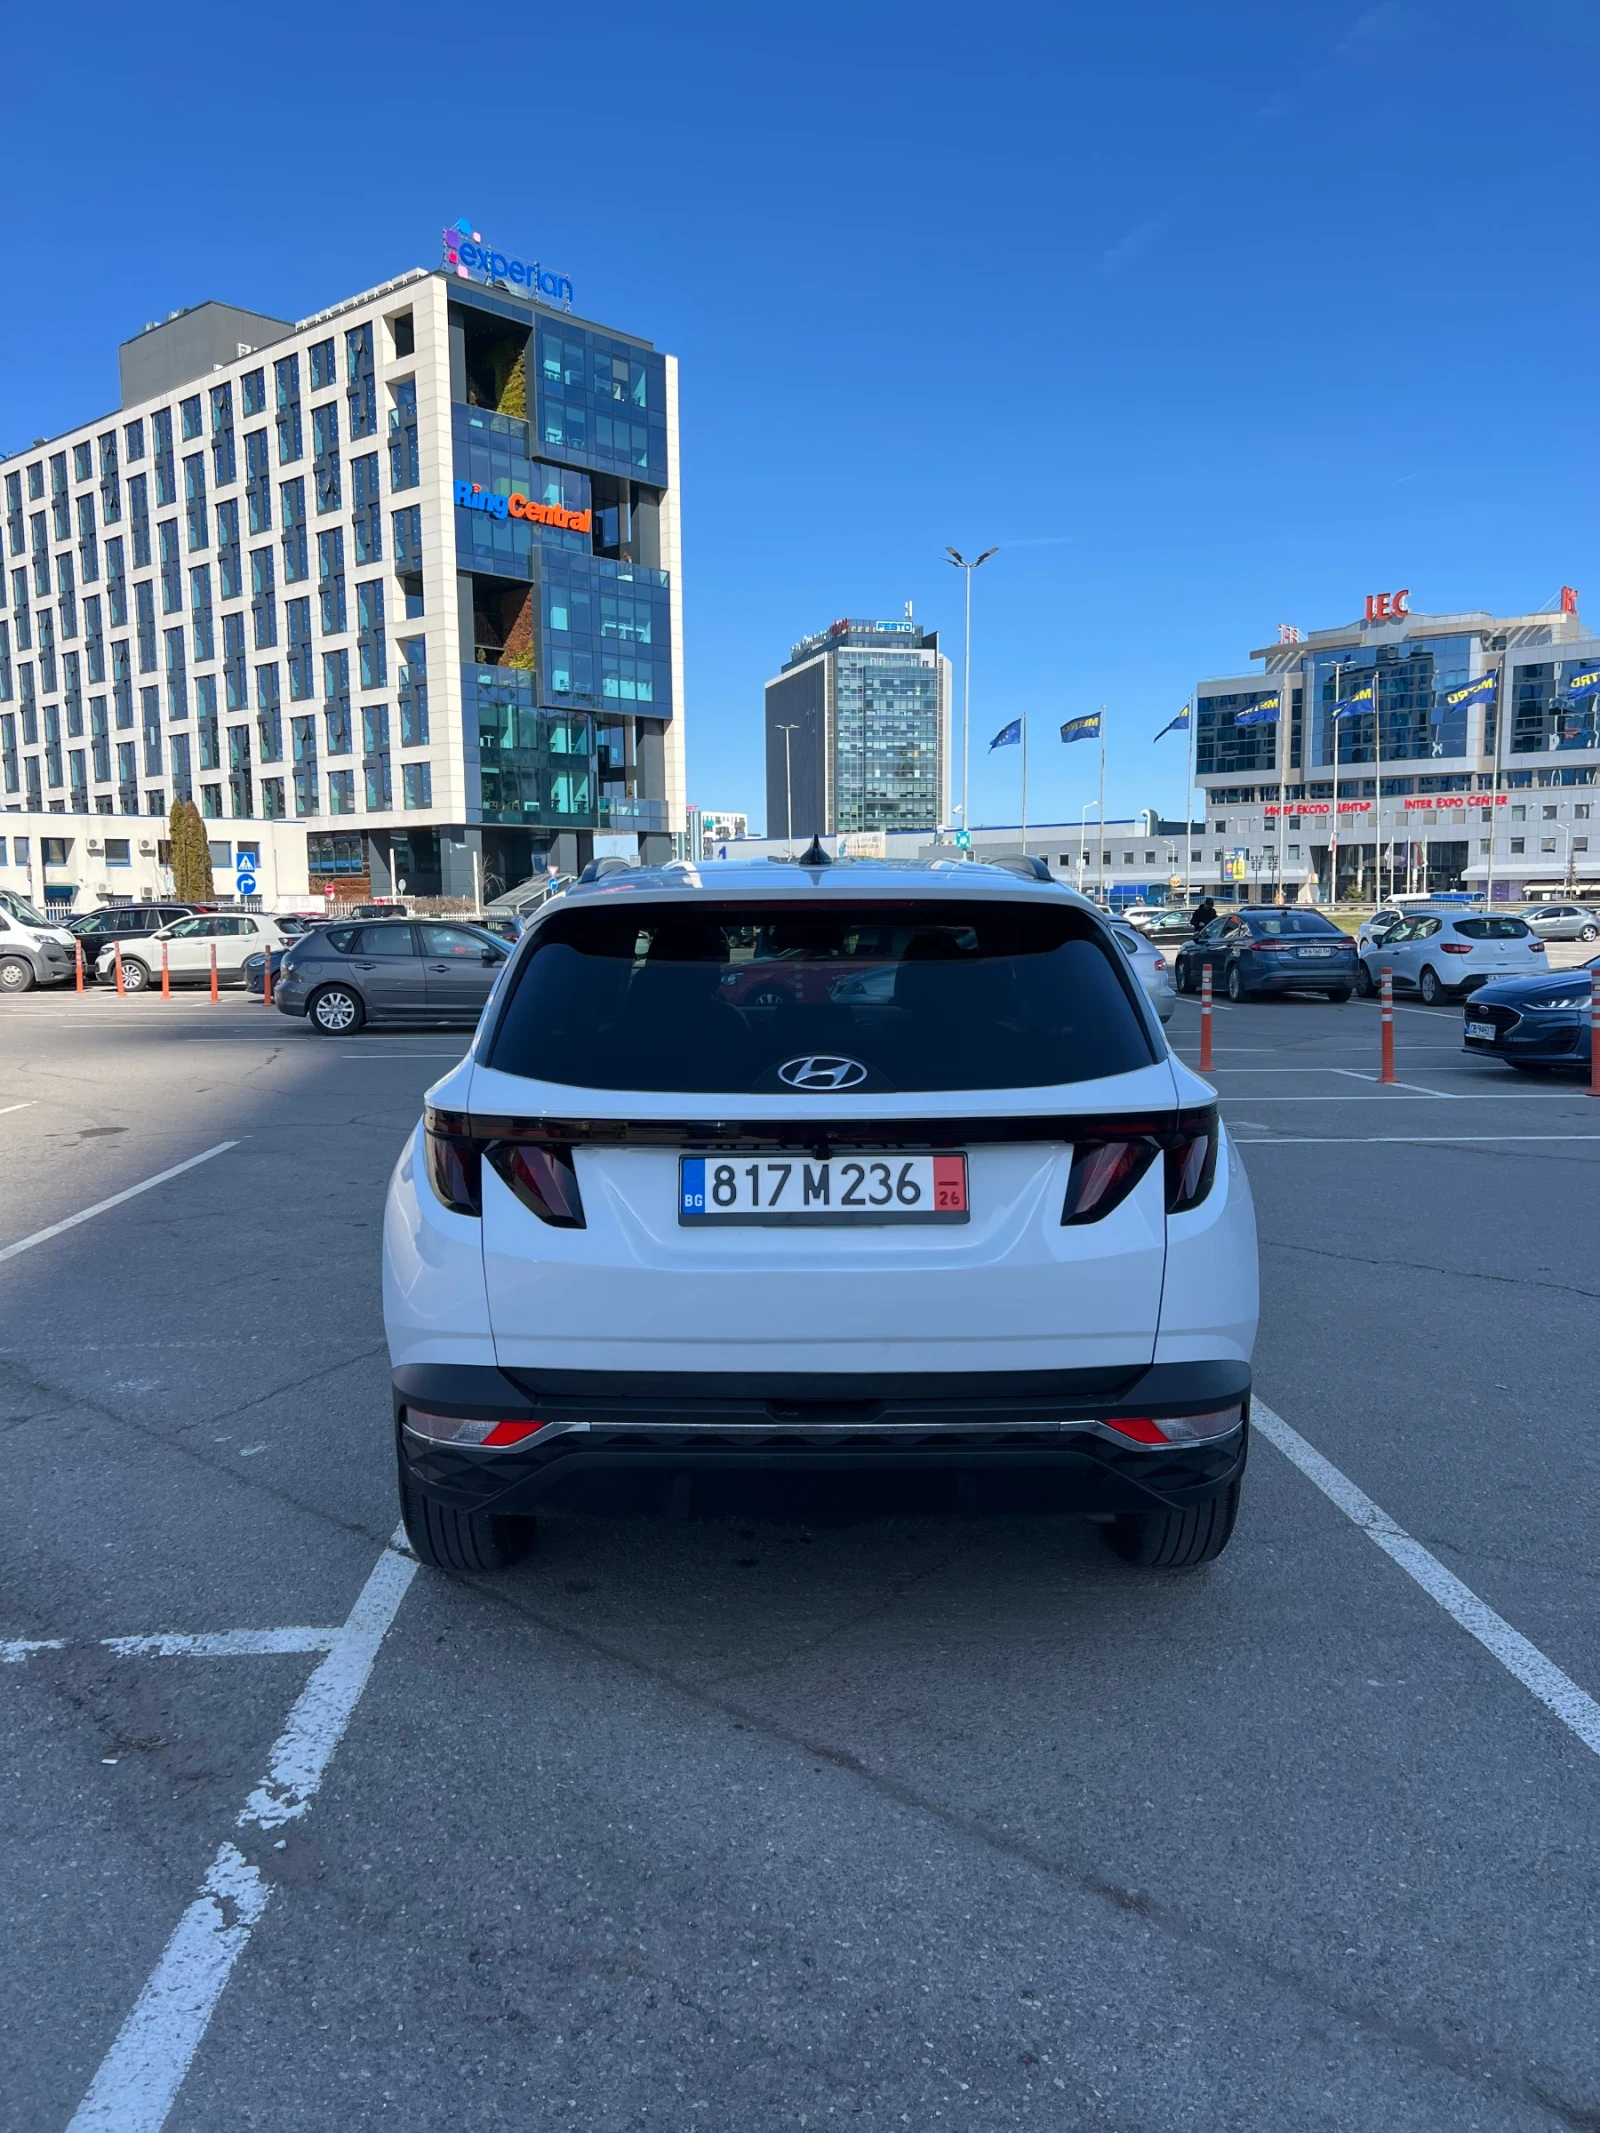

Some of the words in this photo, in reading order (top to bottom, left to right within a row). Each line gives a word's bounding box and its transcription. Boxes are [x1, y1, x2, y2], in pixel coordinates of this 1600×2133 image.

[460, 243, 573, 302] experian
[454, 480, 592, 532] RingCentral
[1365, 590, 1410, 621] IEC
[877, 622, 912, 631] FESTO
[1297, 803, 1330, 814] ЕКСПО
[1404, 799, 1432, 809] INTER
[1436, 797, 1464, 808] EXPO
[684, 1195, 703, 1207] BG
[939, 1191, 961, 1205] 26
